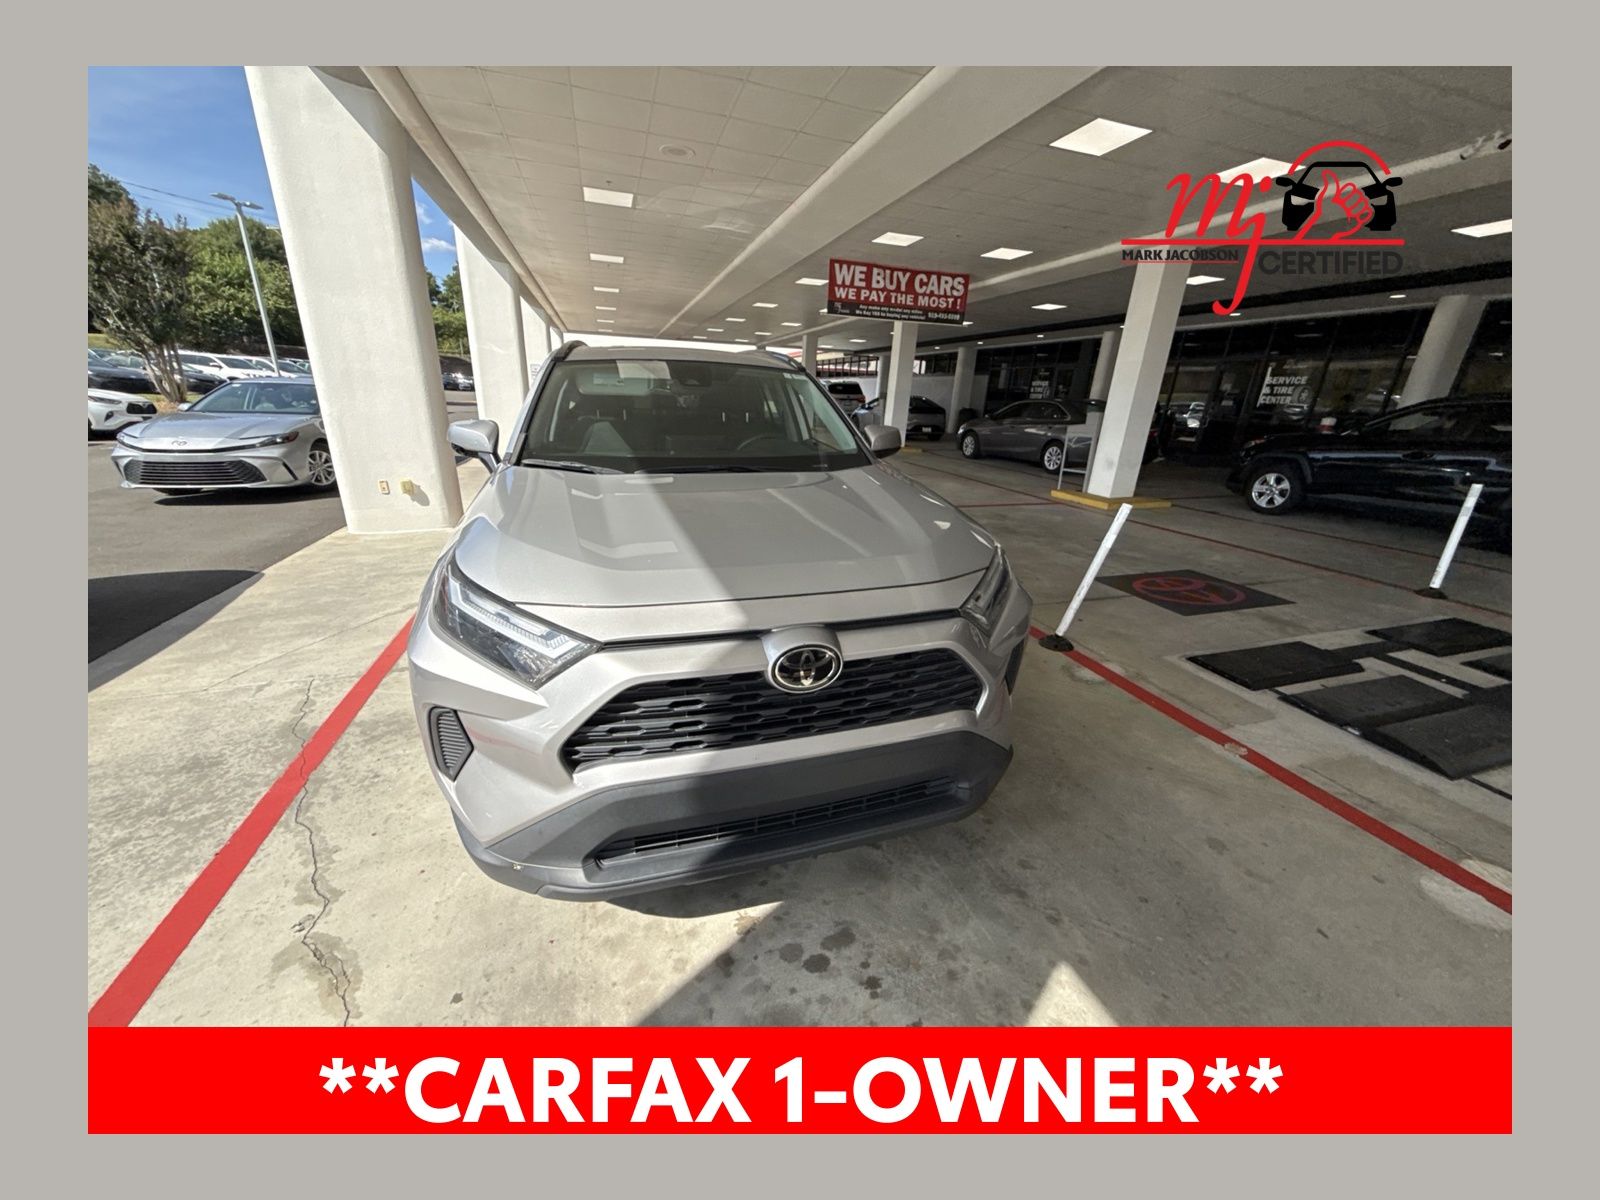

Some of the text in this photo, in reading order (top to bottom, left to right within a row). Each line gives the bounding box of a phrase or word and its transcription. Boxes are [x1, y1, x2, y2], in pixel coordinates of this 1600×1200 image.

[834, 263, 965, 297] WE BUY CARS
[834, 286, 857, 300] WE
[860, 289, 887, 302] PAY
[890, 292, 914, 306] THE
[1265, 376, 1308, 385] SERVICE
[1273, 386, 1295, 394] TIRE
[1260, 395, 1292, 405] CENTER
